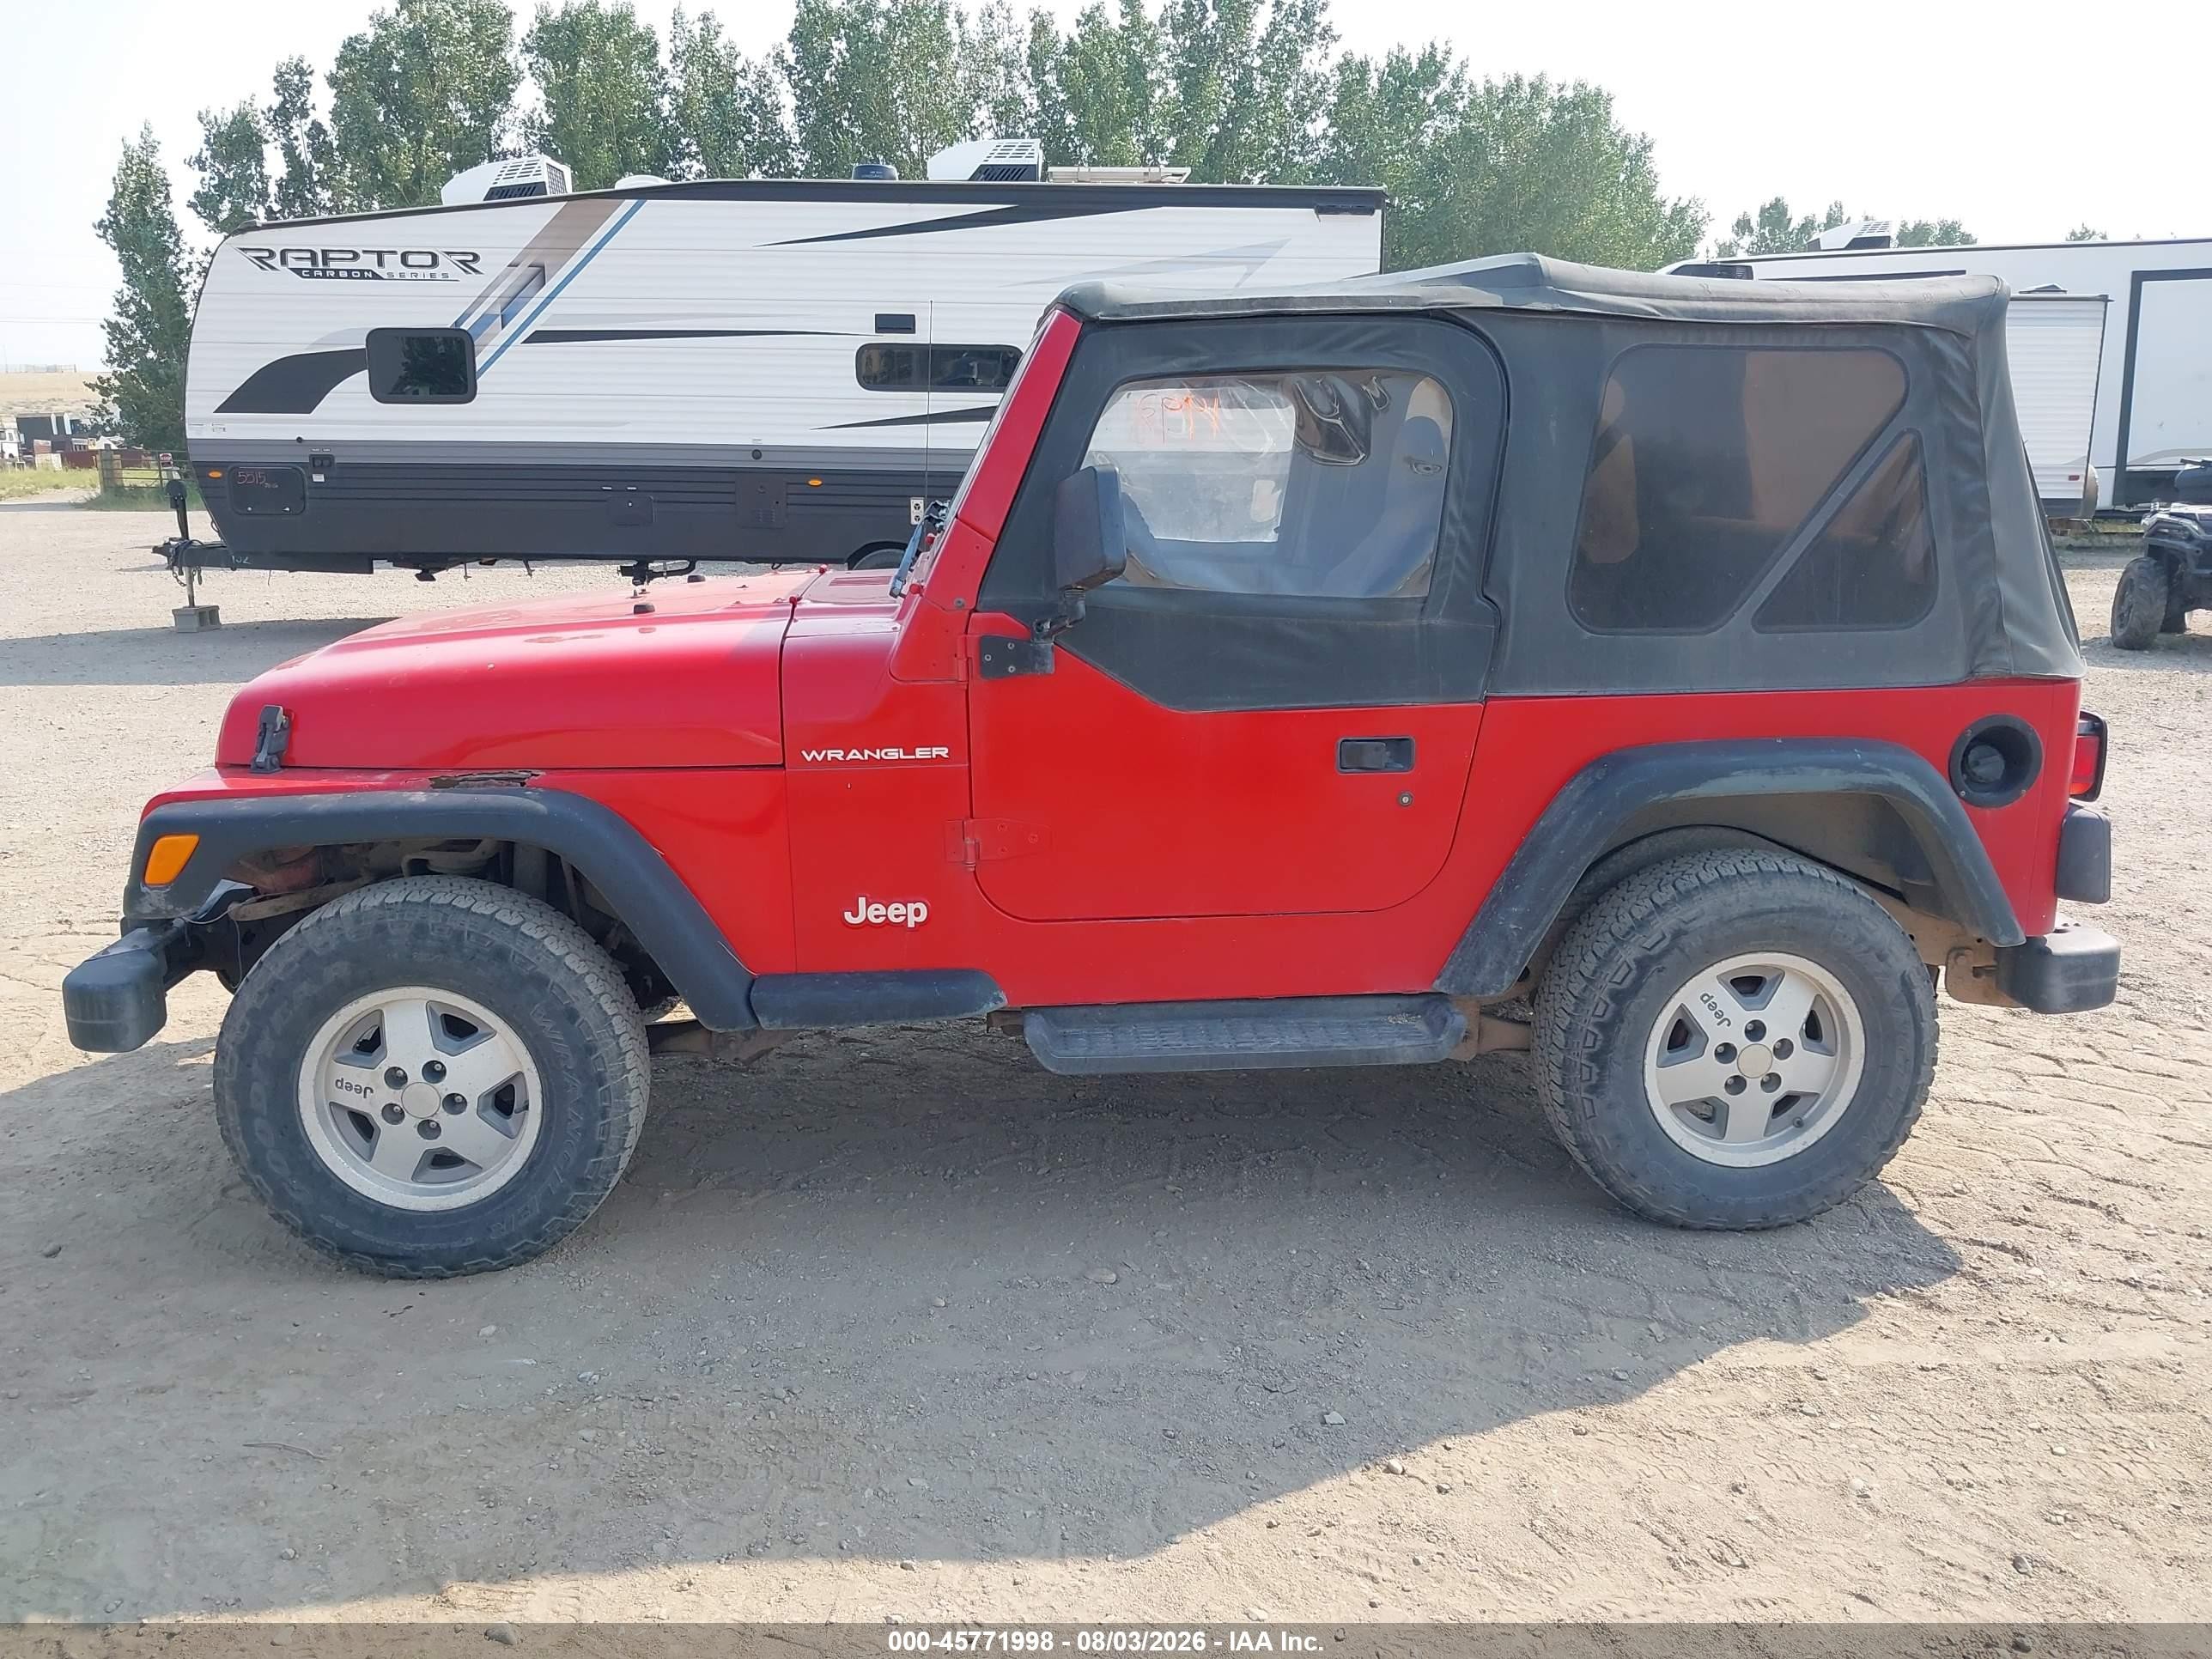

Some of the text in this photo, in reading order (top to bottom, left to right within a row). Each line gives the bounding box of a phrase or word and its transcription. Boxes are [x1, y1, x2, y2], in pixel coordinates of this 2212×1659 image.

[236, 246, 484, 276] RAPTOR
[301, 270, 374, 279] CARBON
[801, 747, 949, 762] WRANGLER
[843, 896, 928, 928] Jeep
[1700, 993, 1732, 1027] Jeep
[335, 1078, 374, 1099] Jeep
